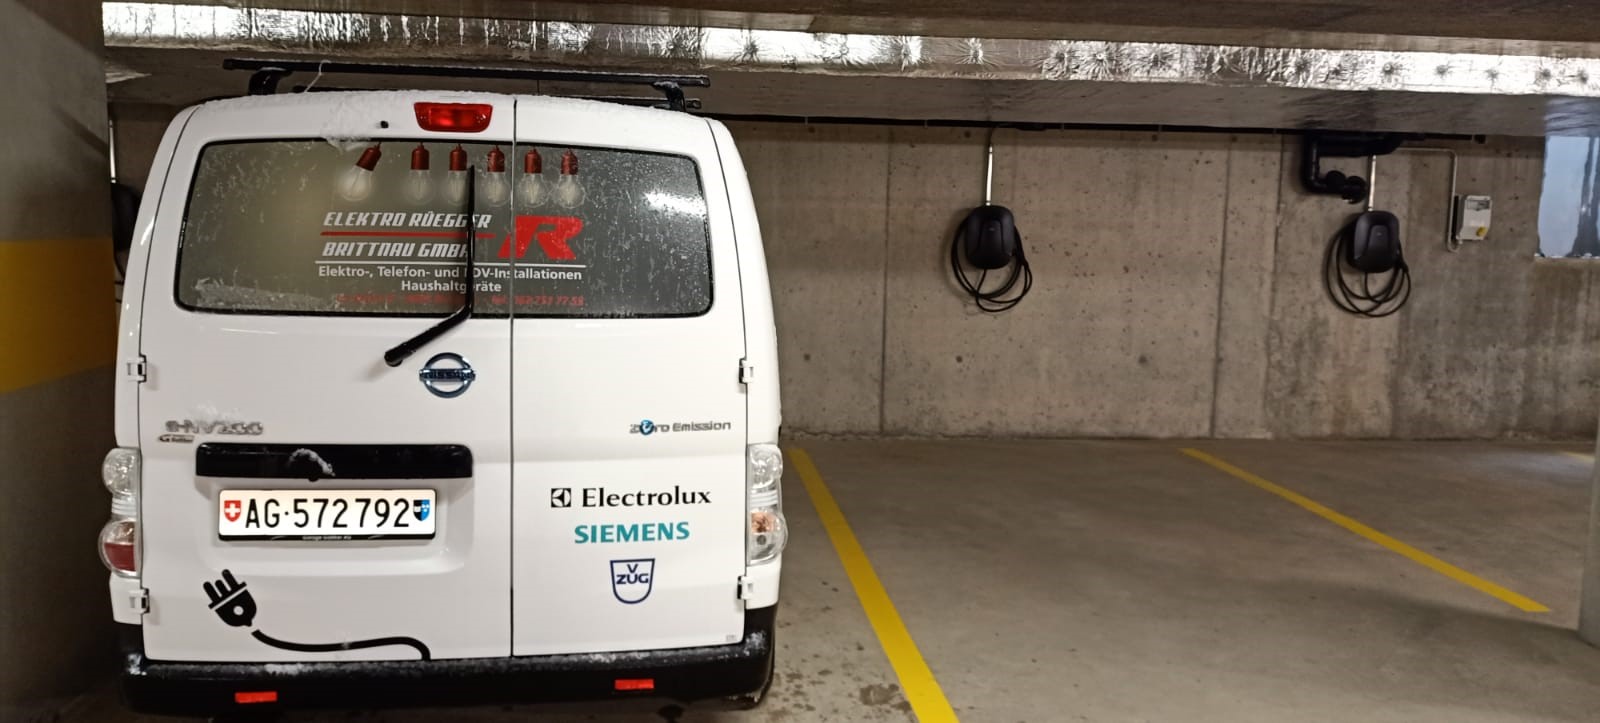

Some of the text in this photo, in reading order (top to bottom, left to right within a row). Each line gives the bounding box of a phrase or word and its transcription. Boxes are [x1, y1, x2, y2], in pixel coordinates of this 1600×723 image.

[323, 211, 406, 227] ELEKTRO
[322, 241, 415, 257] BRITTNAU
[319, 266, 582, 281] Elektro-, Telefon- und DV-Installationen
[401, 279, 502, 294] Haushaltgräte
[672, 421, 731, 432] Emission
[582, 486, 711, 508] Electrolux
[574, 521, 690, 544] SIEMENS
[627, 564, 638, 573] V
[616, 573, 649, 585] ZUG
